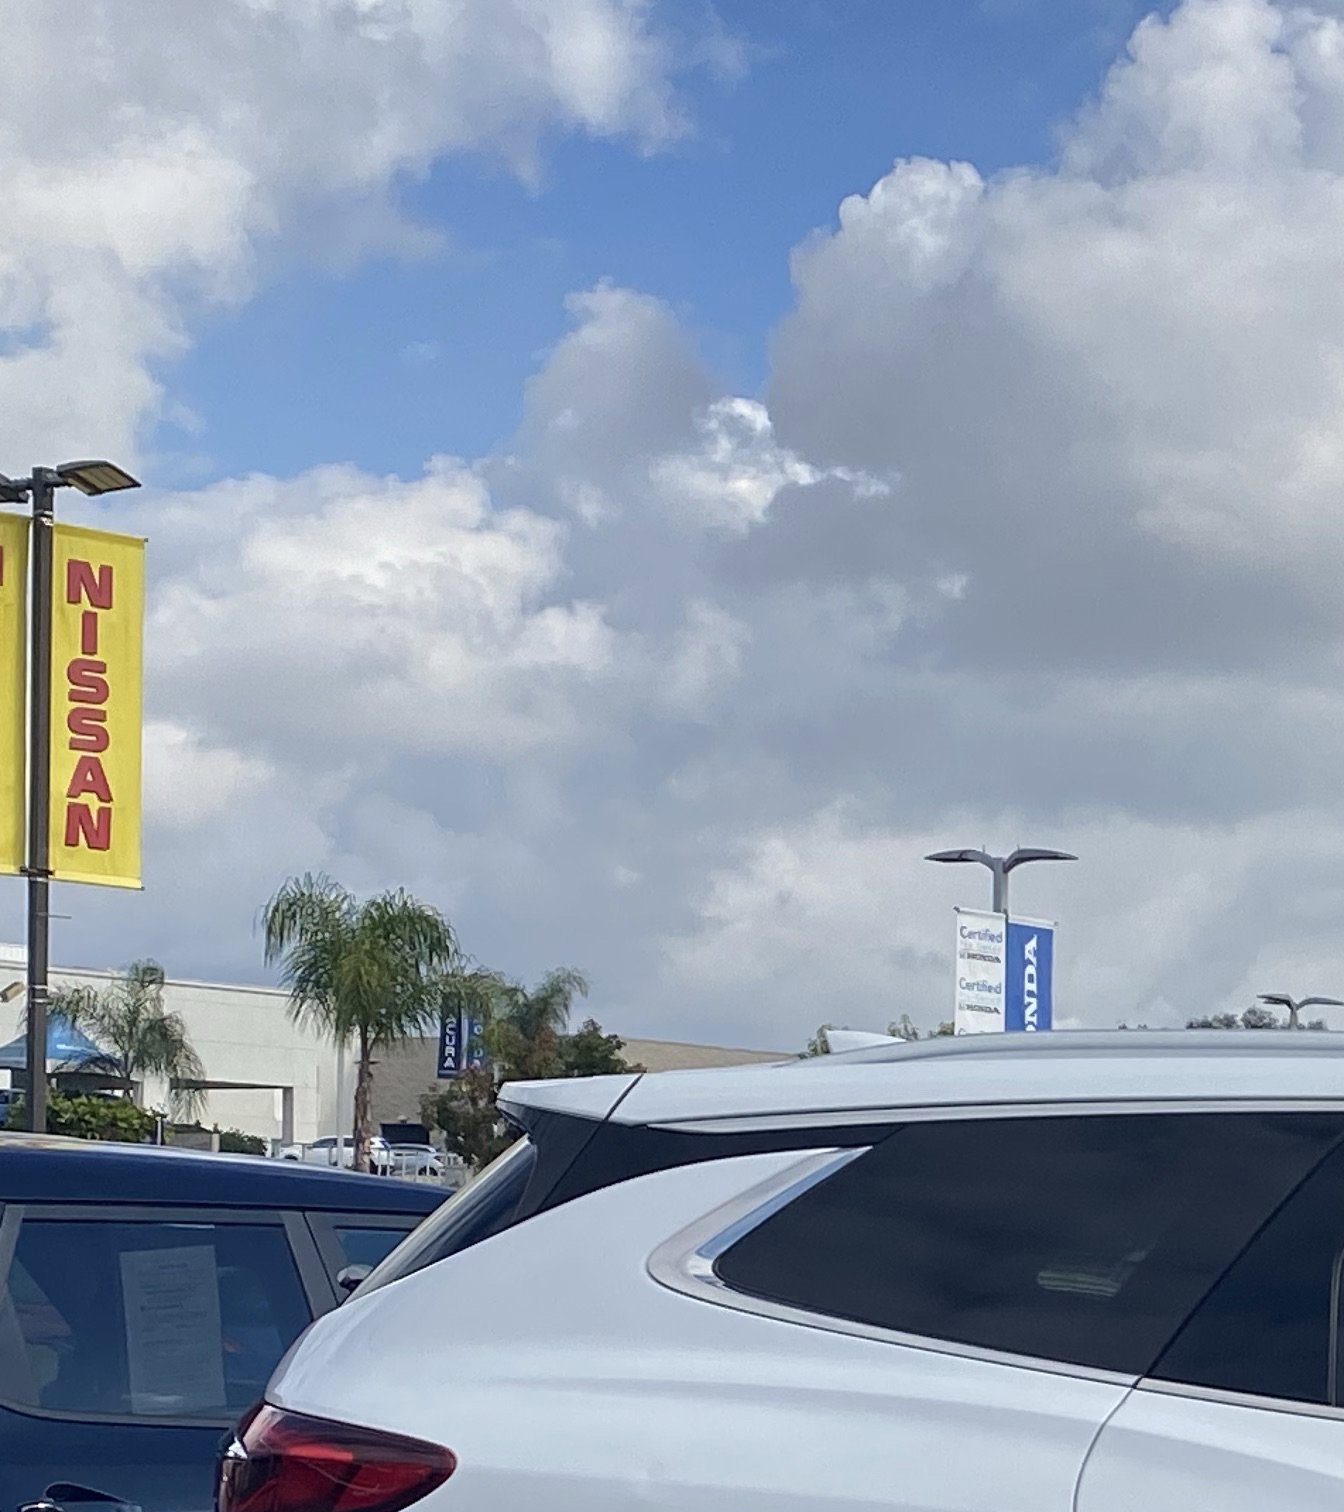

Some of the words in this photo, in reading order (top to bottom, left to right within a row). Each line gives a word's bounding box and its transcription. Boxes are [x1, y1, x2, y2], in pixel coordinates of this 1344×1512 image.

[65, 558, 114, 851] NISSAN
[960, 926, 1003, 943] Certified
[959, 977, 1002, 994] Certified
[1024, 934, 1038, 1031] NDA
